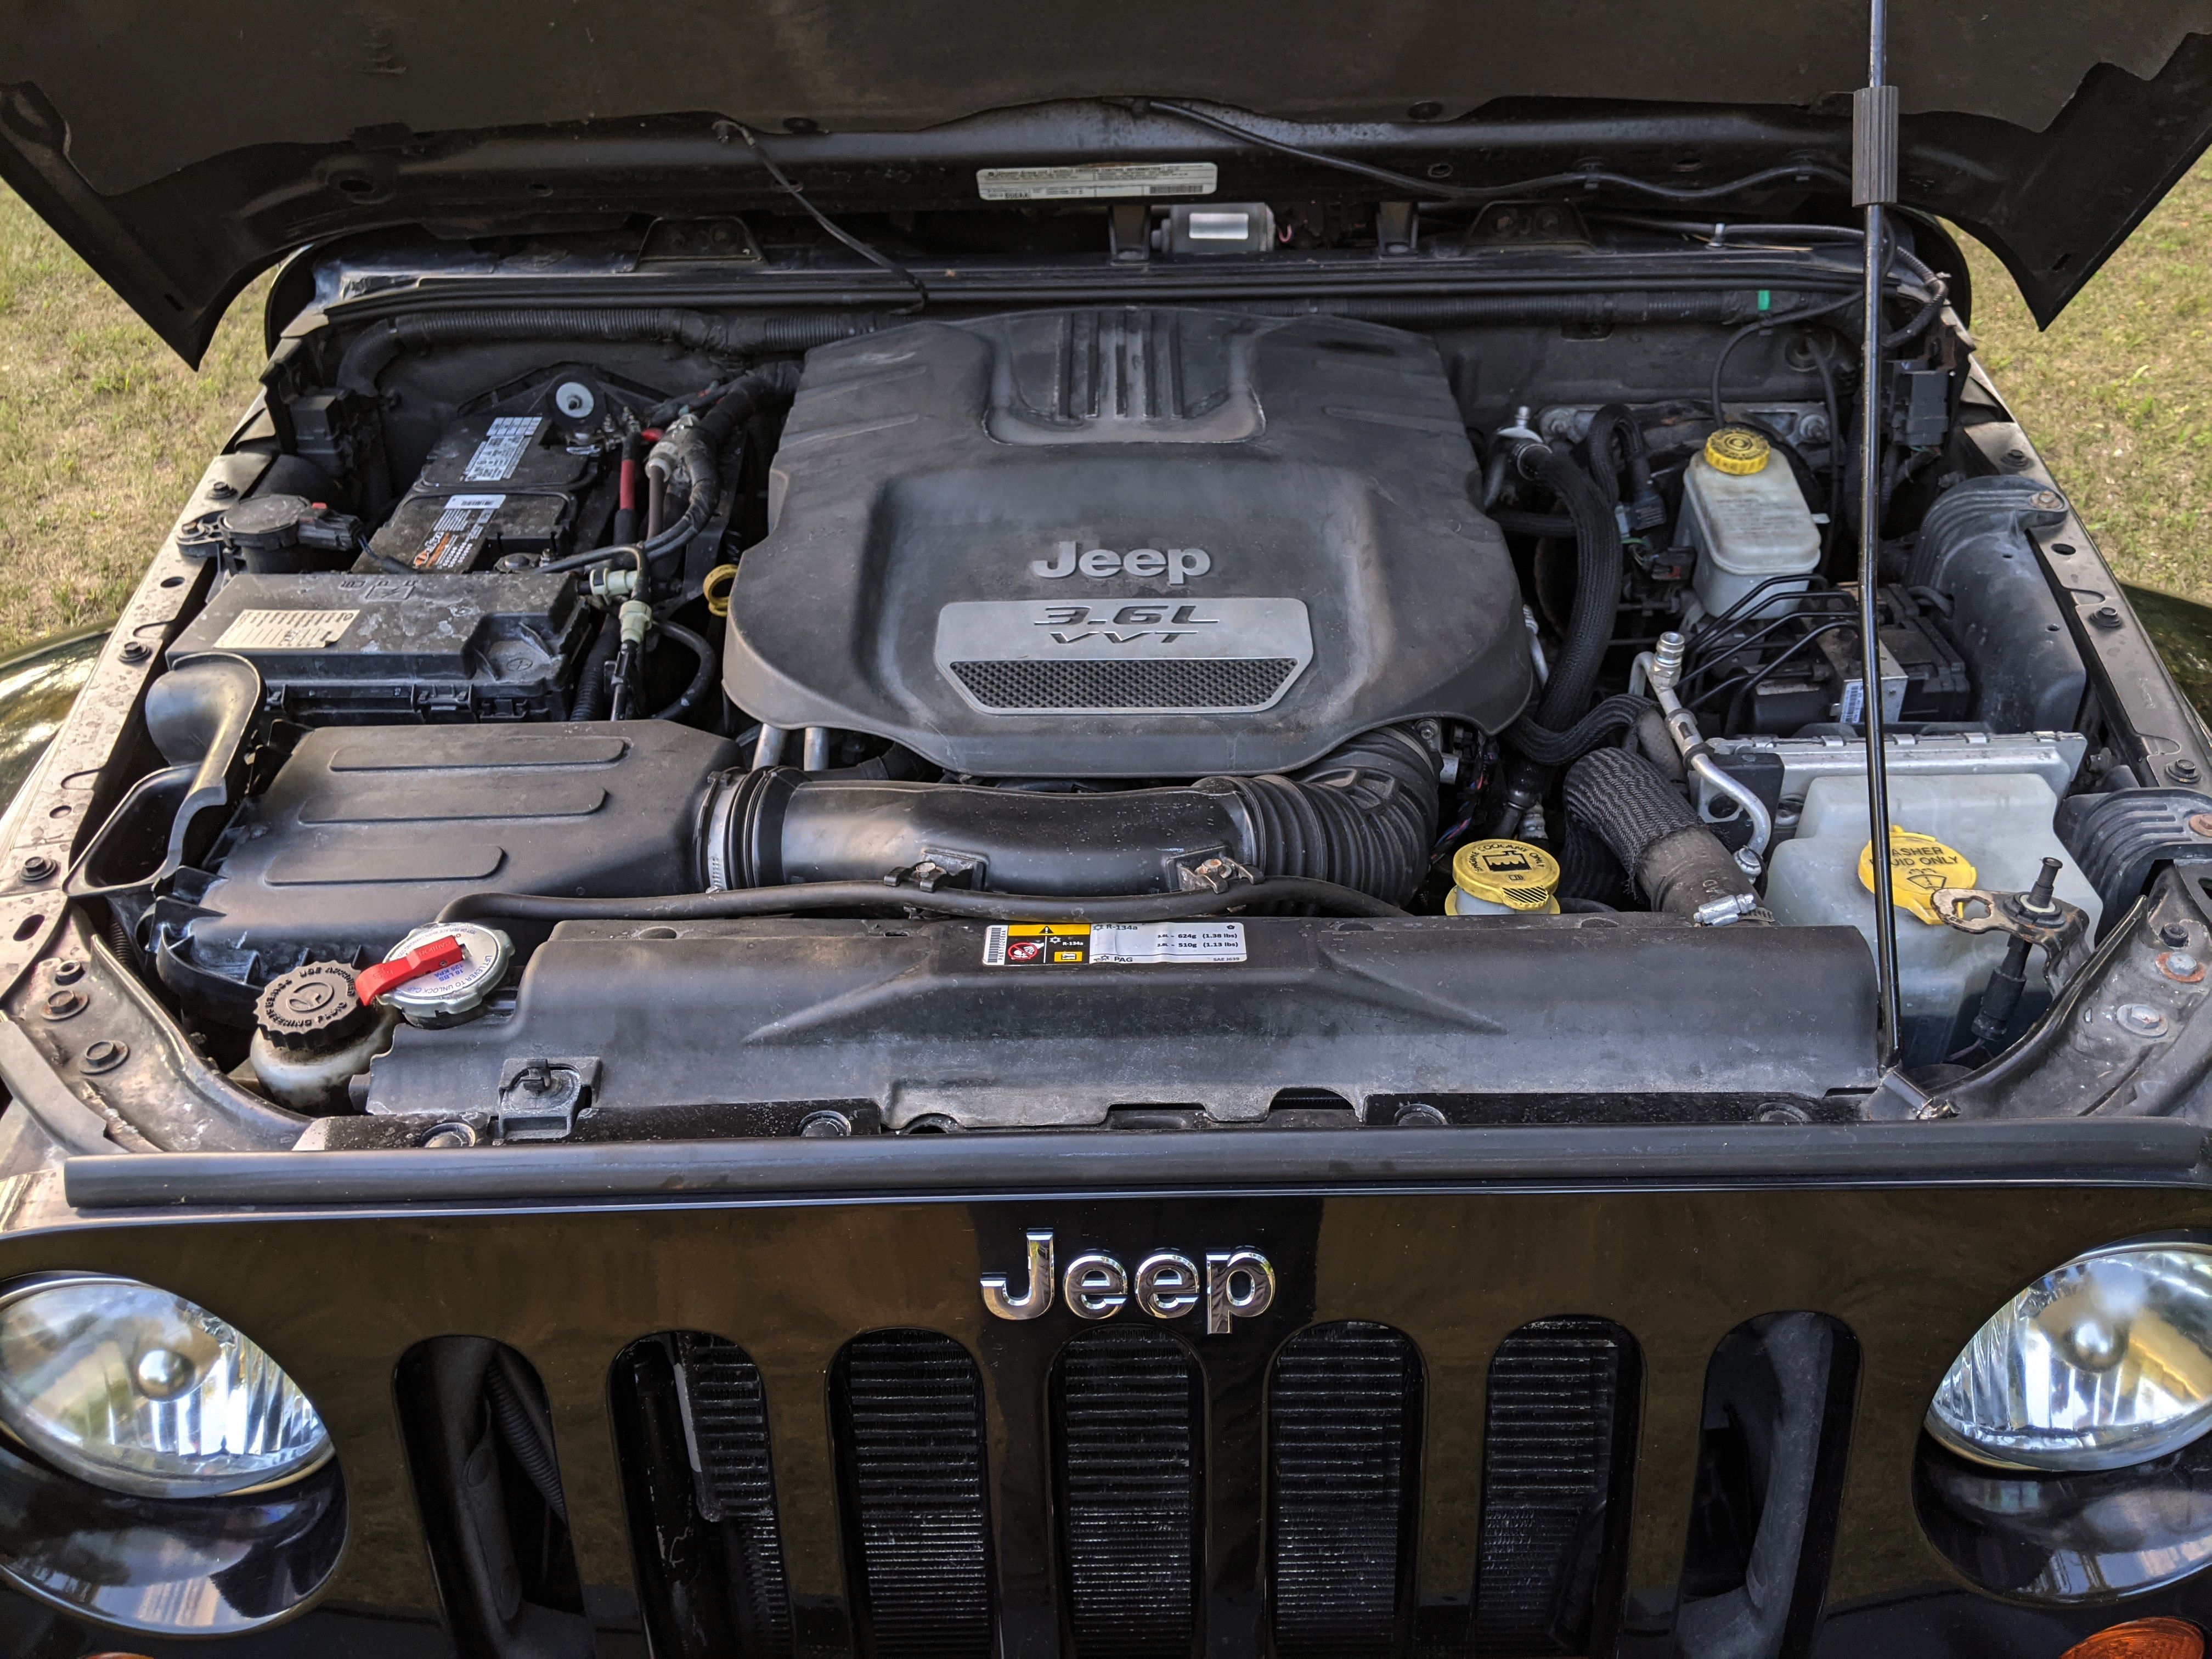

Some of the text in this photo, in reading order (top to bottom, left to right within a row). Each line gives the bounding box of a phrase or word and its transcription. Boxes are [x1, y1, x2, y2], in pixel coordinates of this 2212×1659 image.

[1032, 541, 1211, 585] Jeep
[1034, 605, 1220, 625] 3.6L
[1048, 630, 1199, 644] VVT
[1470, 843, 1545, 873] ENGINE COOLANT ONLY
[1892, 847, 1944, 856] ASHER
[1919, 855, 1959, 865] ONLY
[483, 955, 492, 969] LIFT
[433, 968, 449, 977] KPA
[438, 973, 454, 981] LBS
[465, 966, 483, 982] LEVER
[422, 985, 453, 994] UNLOCK
[266, 1009, 313, 1027] STEERING
[980, 1228, 1276, 1334] Jeep
